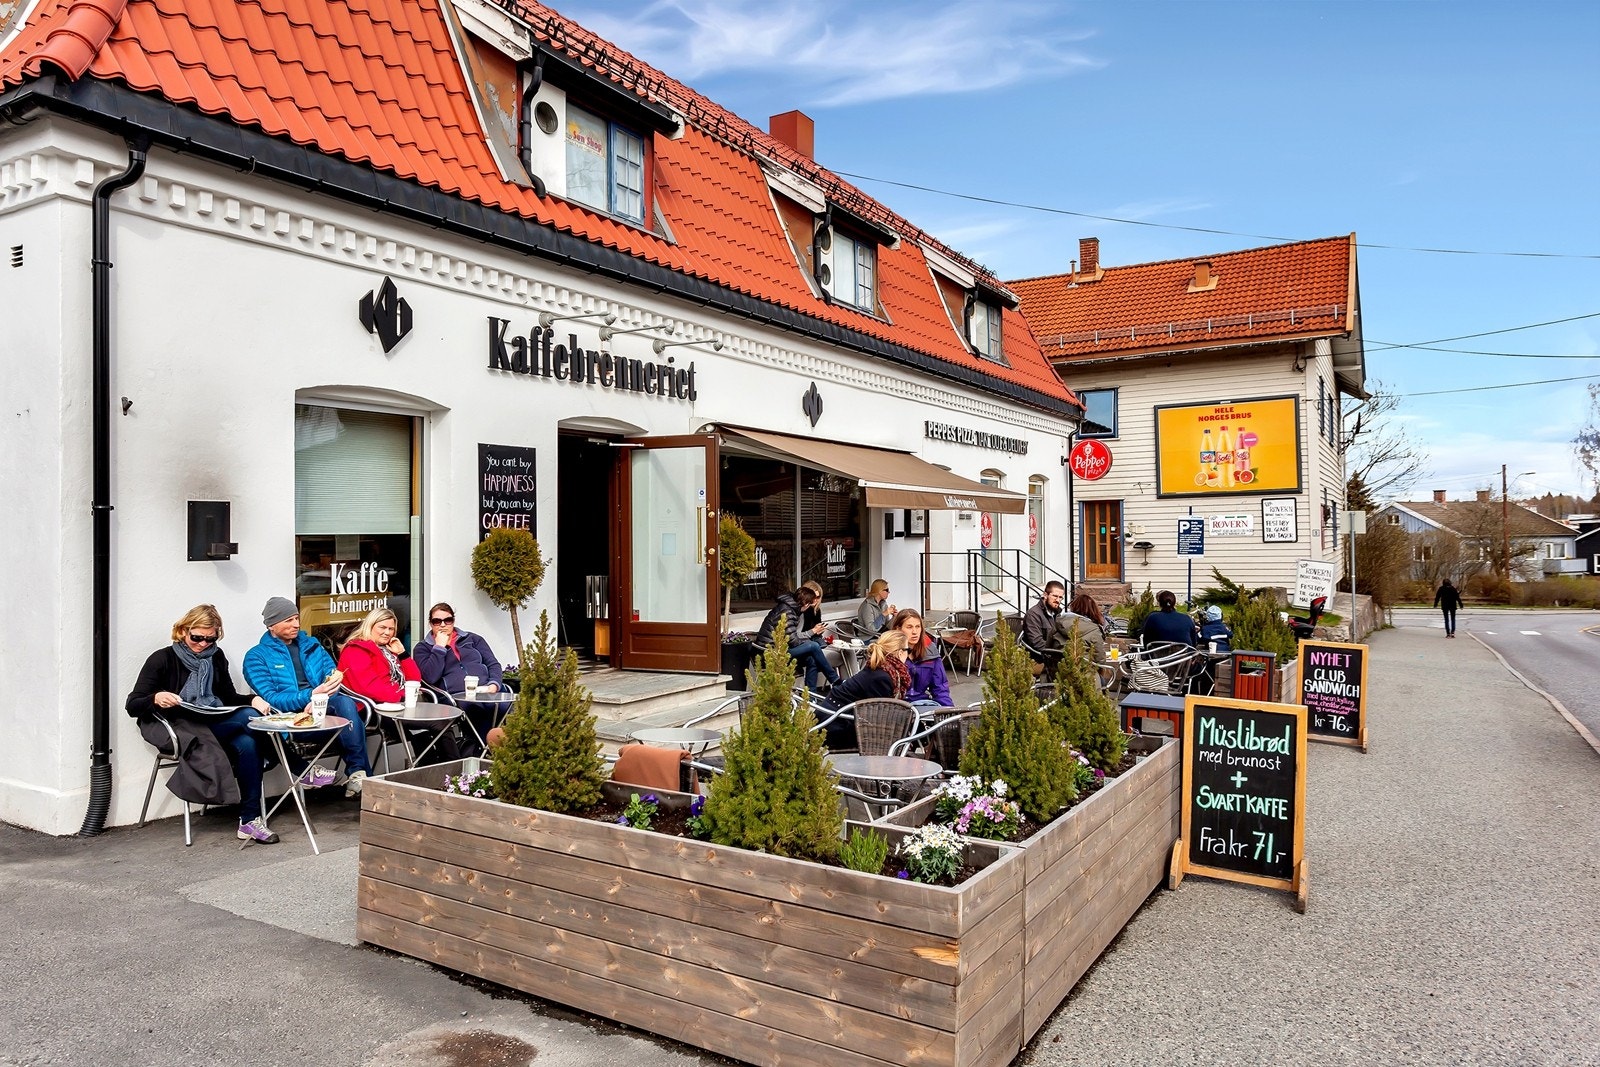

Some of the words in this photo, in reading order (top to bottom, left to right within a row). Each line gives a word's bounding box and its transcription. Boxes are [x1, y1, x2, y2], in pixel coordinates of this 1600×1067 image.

[487, 316, 697, 401] Kaffebrenneriet
[1198, 414, 1230, 422] NORGES
[1231, 412, 1252, 420] BRUS
[957, 427, 978, 446] PIZZA
[519, 458, 532, 473] buy
[1075, 454, 1106, 470] Peppes
[483, 473, 535, 493] HAPPINESS
[482, 494, 494, 509] but
[495, 500, 509, 513] you
[509, 500, 521, 509] can
[522, 498, 535, 511] buy
[482, 512, 531, 531] COFFEE
[1180, 521, 1190, 533] P
[755, 546, 768, 568] ffe
[827, 544, 846, 562] Kaffe
[330, 562, 389, 595] Kaffe
[330, 595, 389, 614] brenneriet
[1310, 652, 1352, 668] NYHET
[1314, 668, 1346, 683] CLUB
[1304, 679, 1360, 698] SANDWICH
[1314, 714, 1326, 727] kr
[1199, 717, 1290, 755] Müslibrød
[1200, 749, 1223, 764] med
[1227, 750, 1281, 770] brunost
[1196, 785, 1245, 812] SVART
[1246, 794, 1288, 820] KAFFE
[1200, 826, 1226, 854] Fra
